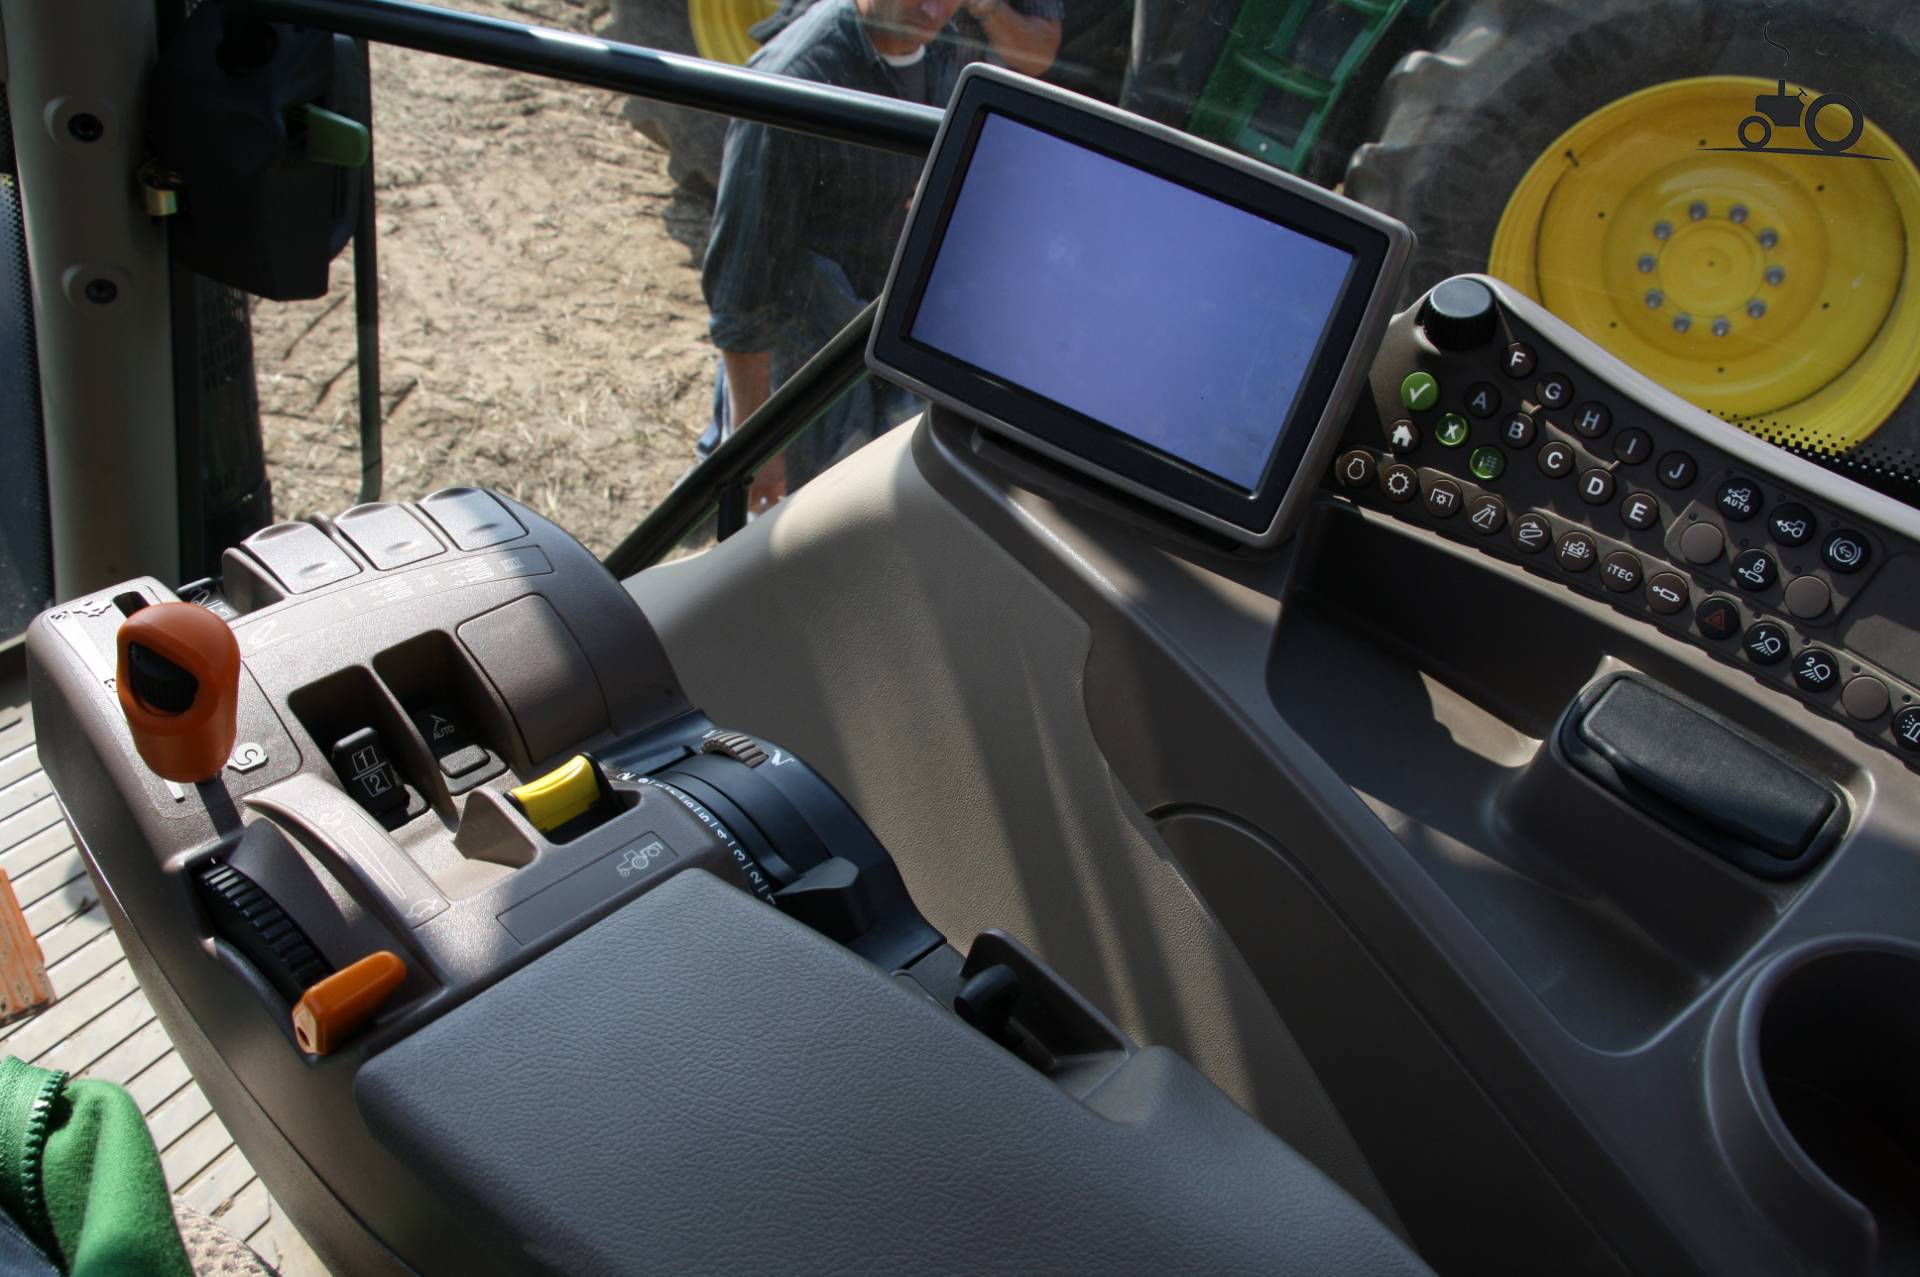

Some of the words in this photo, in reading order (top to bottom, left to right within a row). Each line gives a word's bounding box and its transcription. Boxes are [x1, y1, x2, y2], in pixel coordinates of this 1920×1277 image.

[1510, 351, 1526, 367] F
[1472, 391, 1487, 409] A
[1545, 382, 1562, 400] G
[1582, 410, 1600, 430] H
[1508, 420, 1525, 439] B
[1626, 438, 1637, 455] I
[1547, 451, 1563, 469] C
[1668, 463, 1685, 479] J
[1586, 476, 1604, 496] D
[1629, 502, 1648, 522] E
[1722, 496, 1750, 513] AUTO
[1606, 563, 1634, 582] iTEC
[1759, 631, 1766, 640] 1
[1805, 656, 1815, 667] 2
[432, 724, 455, 740] AUTO
[358, 751, 368, 768] 1
[369, 775, 386, 793] 2
[734, 849, 745, 861] 3
[750, 871, 762, 884] 2
